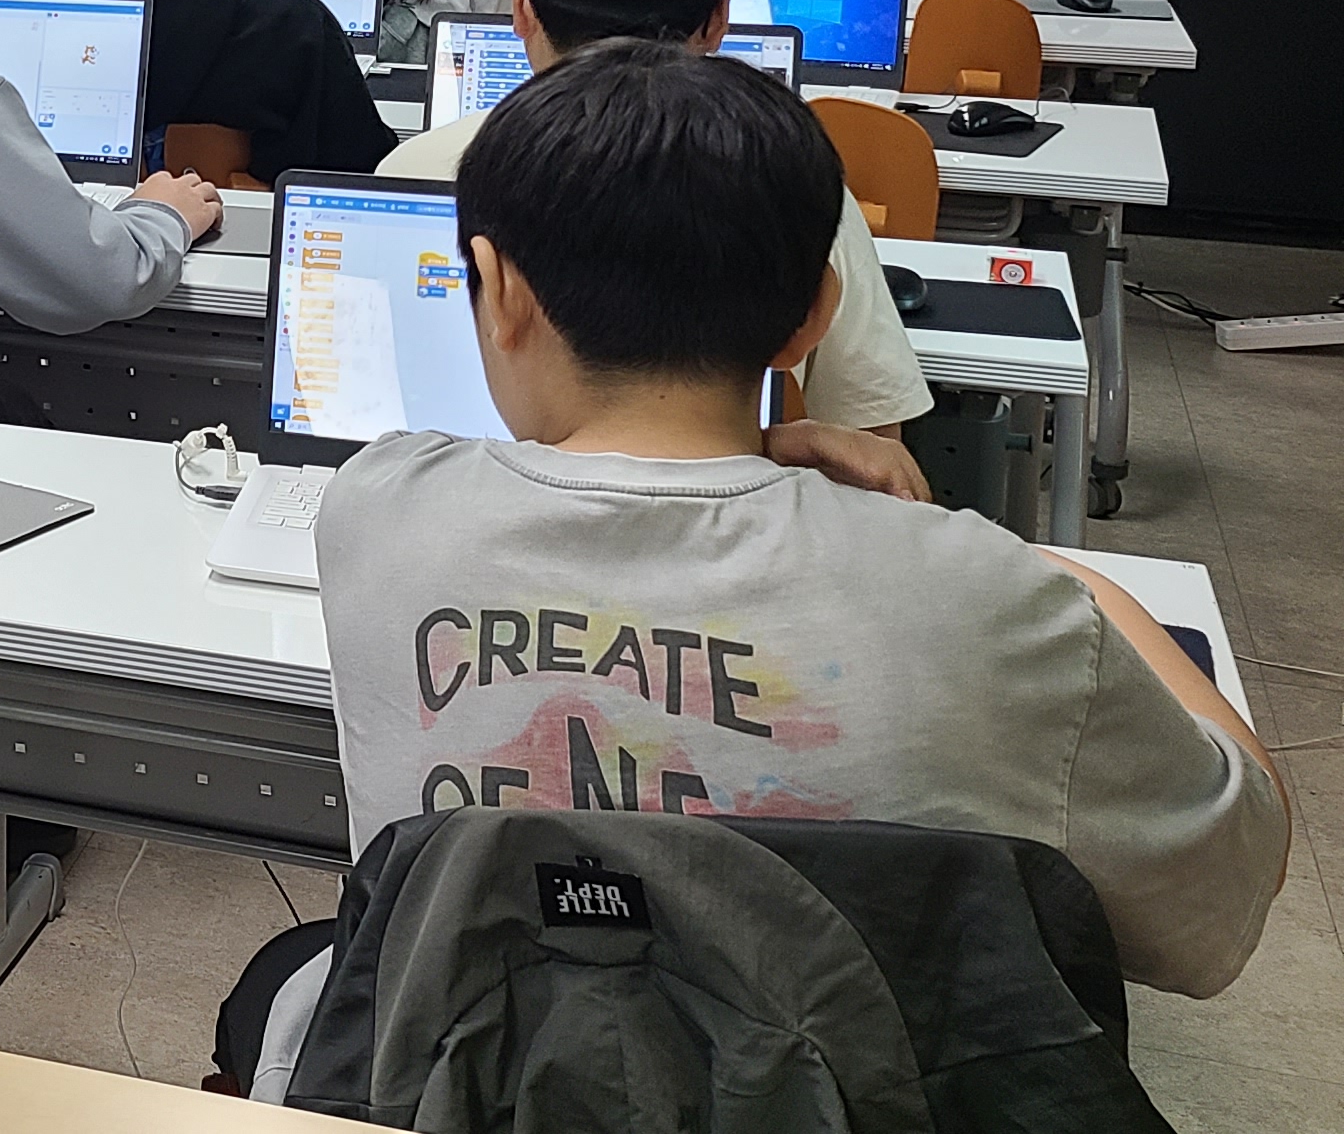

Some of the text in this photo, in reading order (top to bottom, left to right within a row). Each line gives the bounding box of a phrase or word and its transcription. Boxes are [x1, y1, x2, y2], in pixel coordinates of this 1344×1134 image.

[415, 607, 773, 739] CREATE
[553, 878, 621, 902] DEPT.
[556, 895, 631, 918] LITTLE
